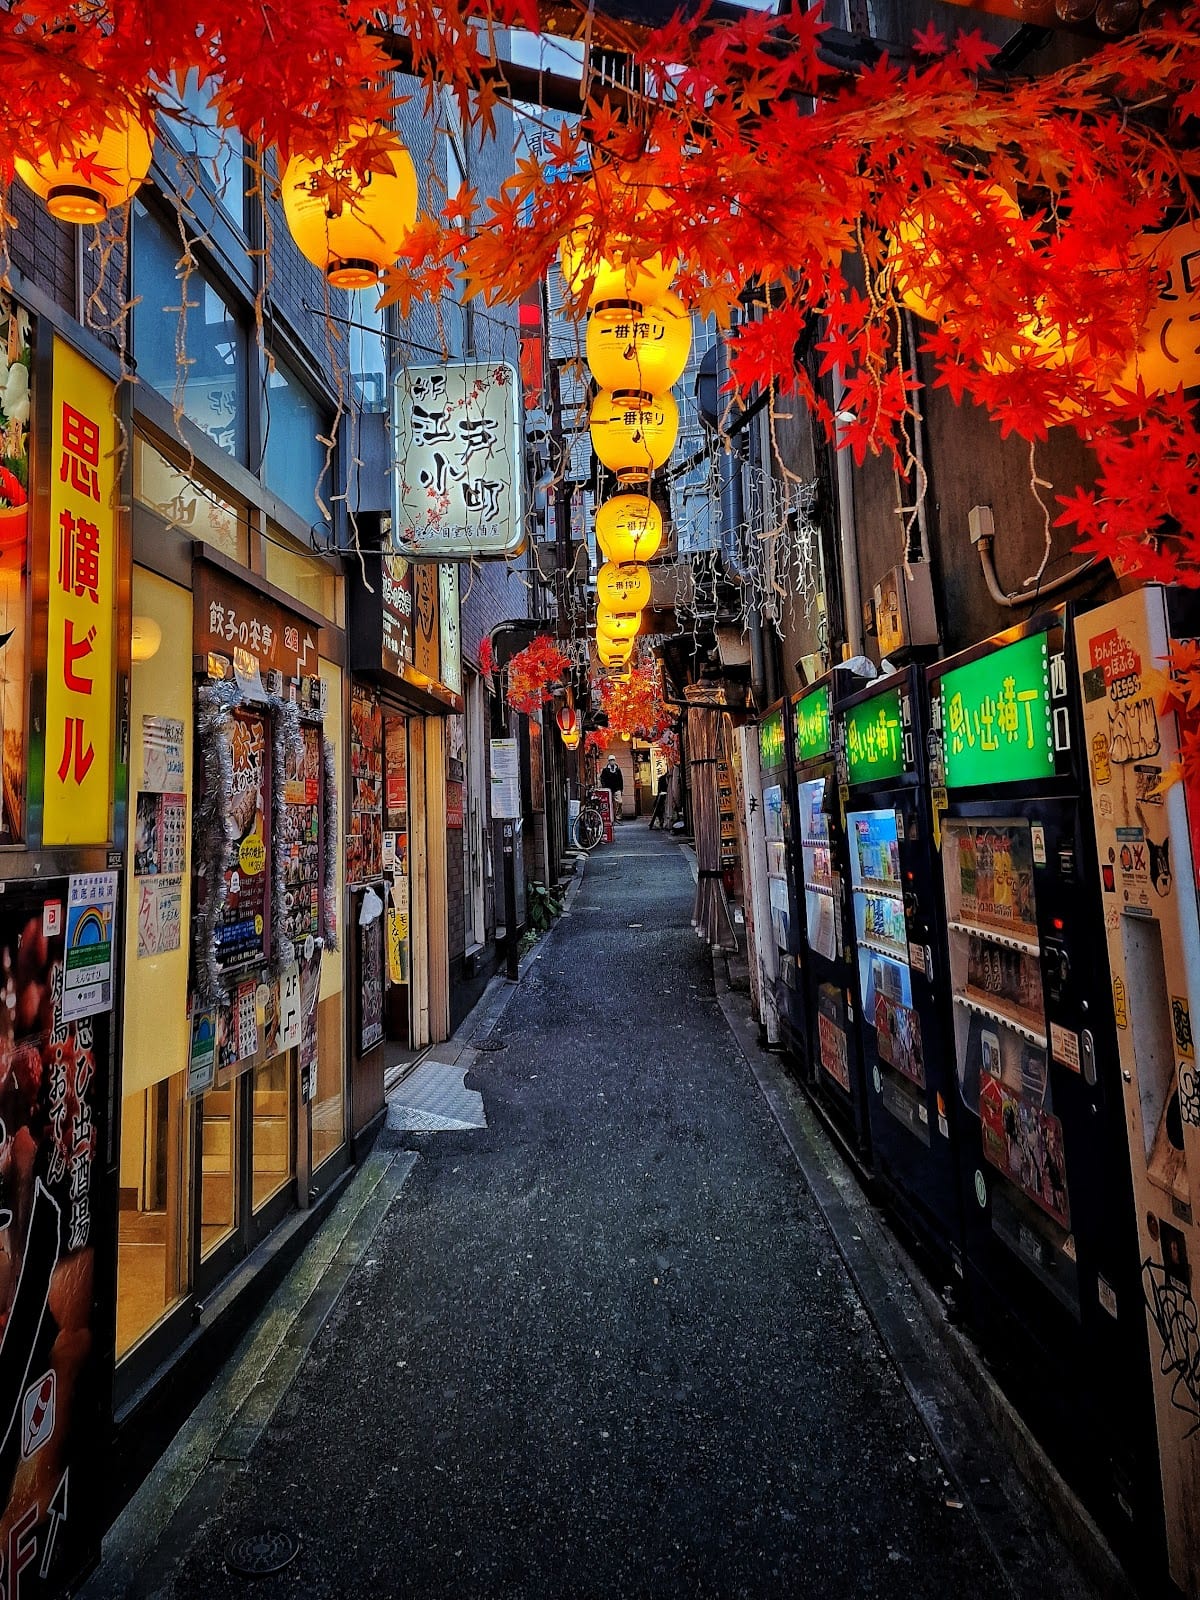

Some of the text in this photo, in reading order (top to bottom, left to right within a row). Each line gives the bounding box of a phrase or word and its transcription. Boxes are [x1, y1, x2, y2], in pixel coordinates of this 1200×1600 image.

[601, 322, 665, 340] 一番搾り
[609, 411, 665, 426] 一番搾り
[411, 404, 505, 522] 江戸小町
[57, 401, 100, 786] 思横ビル
[799, 702, 827, 745] 思い出横丁
[902, 694, 914, 763] 西口
[949, 675, 1038, 755] 思い出横丁
[1049, 652, 1071, 752] 西口
[849, 709, 898, 765] 思い出横丁
[286, 974, 297, 998] 2F
[68, 1016, 94, 1251] 思ひ出酒場
